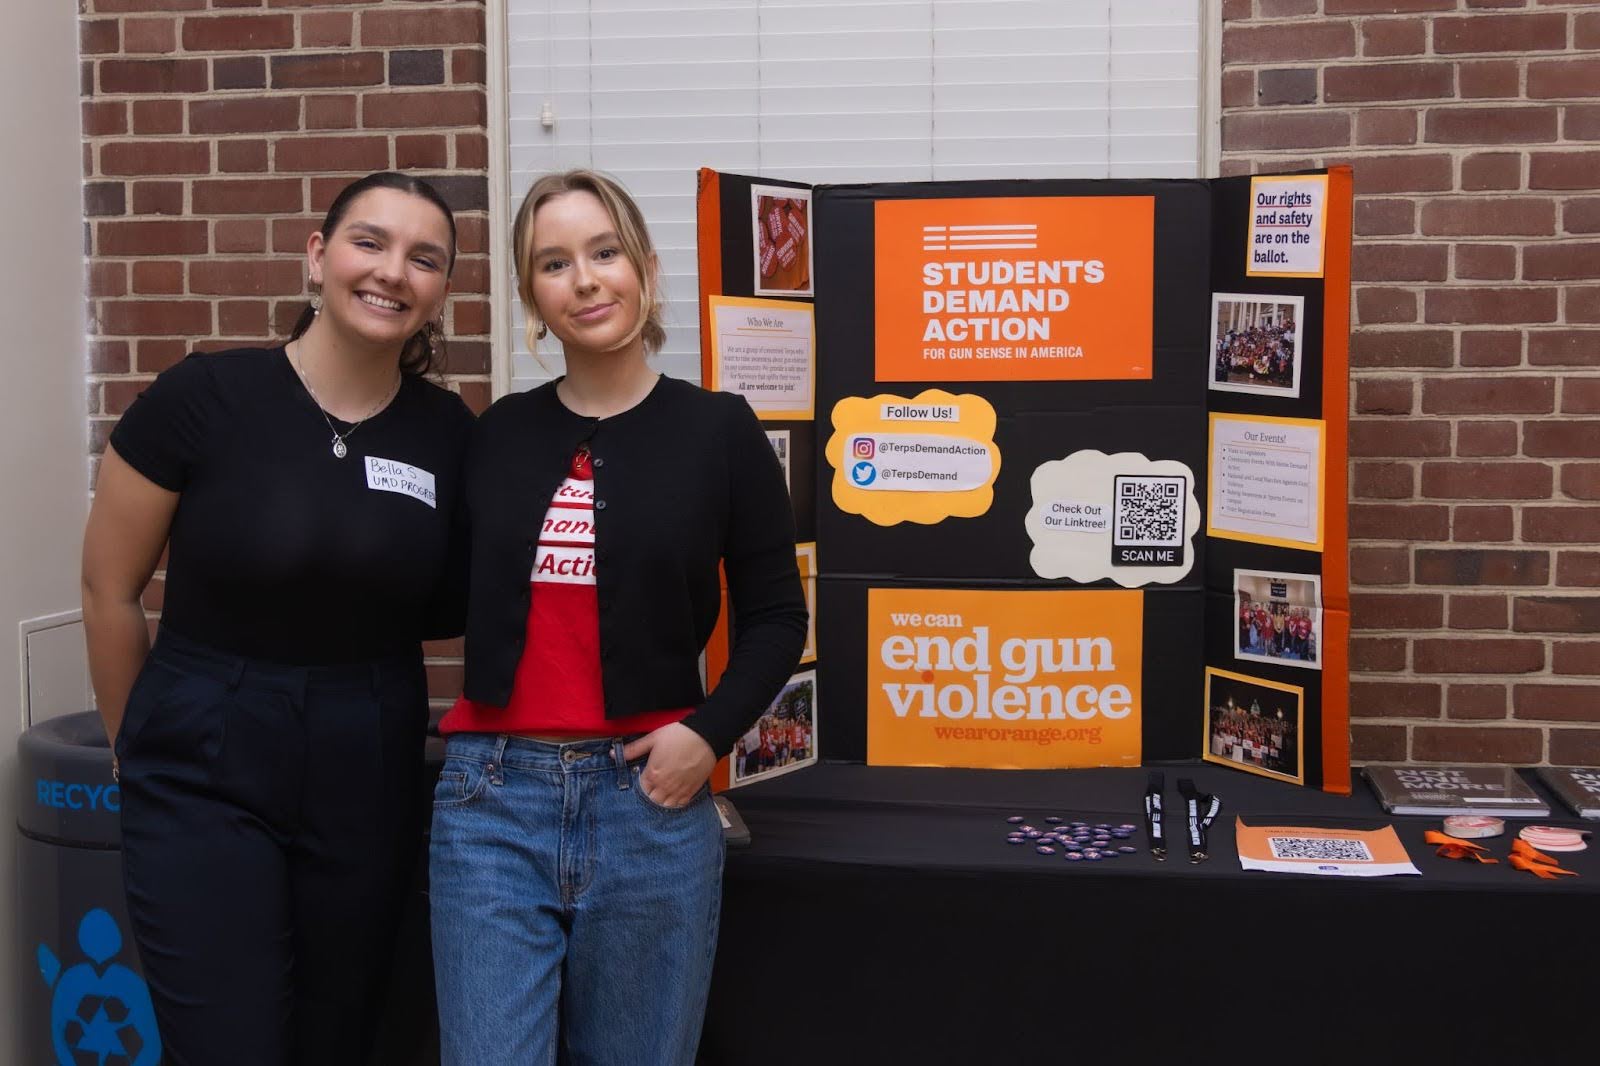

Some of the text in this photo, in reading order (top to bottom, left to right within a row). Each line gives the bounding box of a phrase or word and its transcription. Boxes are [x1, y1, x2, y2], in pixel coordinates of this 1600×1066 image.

[1257, 191, 1312, 208] Our rights
[1256, 211, 1313, 228] and safety
[1255, 230, 1310, 244] are on the
[1254, 249, 1289, 263] ballot.
[923, 260, 1105, 286] STUDENTS
[923, 289, 1070, 314] DEMAND
[746, 317, 784, 328] Who We Are
[922, 317, 1050, 342] ACTION
[923, 346, 1083, 360] FOR GUN SENSE IN AMERICA
[747, 383, 755, 391] are
[756, 382, 777, 391] welcome
[887, 406, 952, 419] Follow Us!
[1244, 431, 1287, 444] Our Events!
[878, 443, 986, 456] @TerpsDemandAction
[370, 458, 417, 479] Bella S
[881, 469, 958, 481] @TerpsDemand
[373, 476, 398, 489] UMD
[1052, 503, 1102, 516] Check Out
[1045, 515, 1107, 529] Our Linktree!
[1121, 549, 1174, 563] SCAN ME
[890, 612, 963, 628] we can
[881, 626, 1115, 684] end gun
[882, 670, 1132, 720] violence
[934, 725, 1102, 746] wearorange.org
[1393, 769, 1465, 777] NOT
[1397, 776, 1473, 784] ONE
[1401, 782, 1505, 791] MORE
